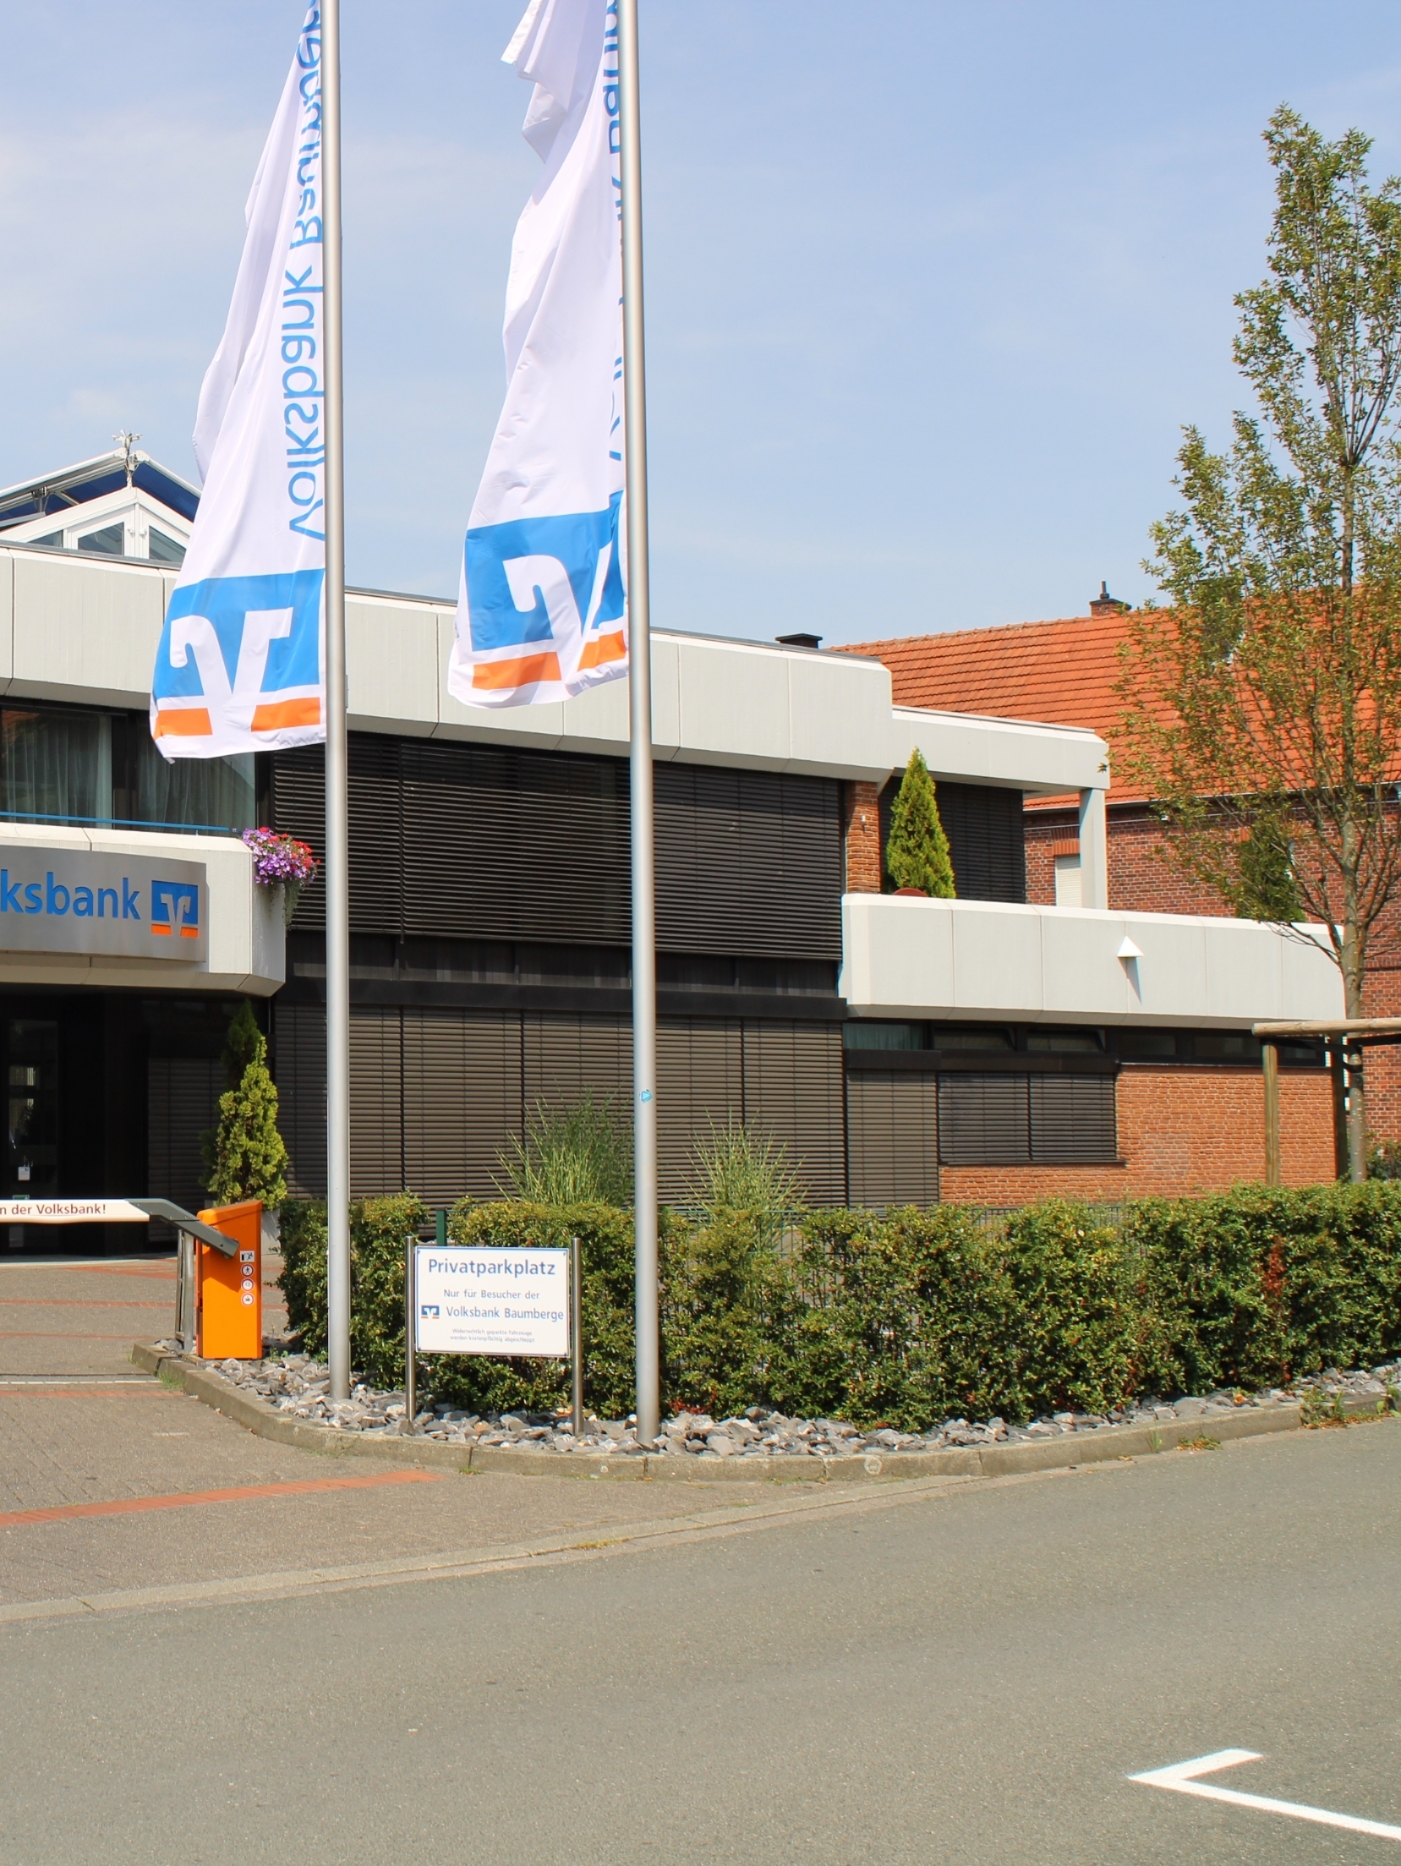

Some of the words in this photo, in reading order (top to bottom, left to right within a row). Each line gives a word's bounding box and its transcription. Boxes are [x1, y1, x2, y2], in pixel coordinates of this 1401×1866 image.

[11, 1203, 32, 1215] der
[36, 1203, 106, 1215] Volksbank!
[428, 1258, 556, 1278] Privatparkplatz
[443, 1289, 460, 1298] Nur
[463, 1288, 477, 1298] für
[480, 1289, 521, 1299] Besucher
[524, 1290, 540, 1299] der
[445, 1305, 500, 1318] Volksbank
[504, 1307, 564, 1323] Baumberge
